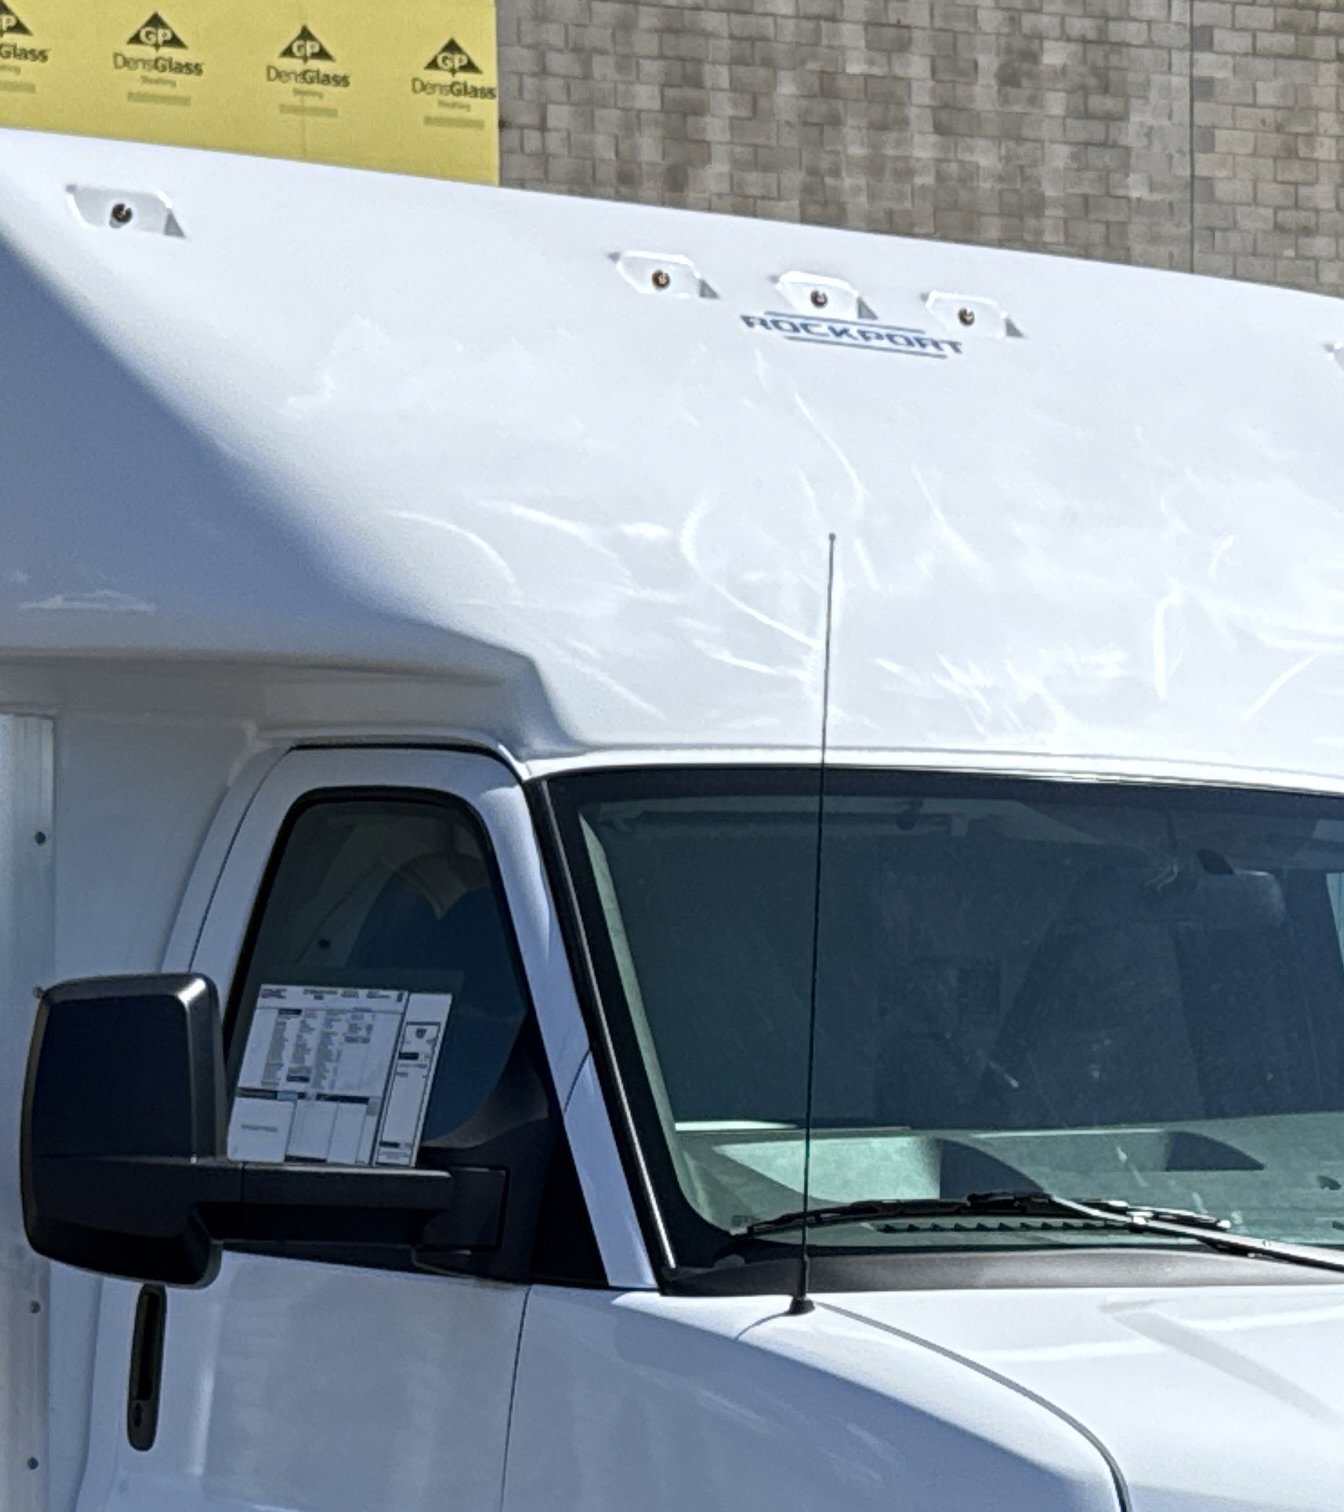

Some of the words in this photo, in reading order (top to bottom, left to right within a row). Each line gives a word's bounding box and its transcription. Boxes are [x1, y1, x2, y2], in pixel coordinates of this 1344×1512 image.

[139, 26, 173, 45] GP
[291, 39, 321, 58] GP
[112, 52, 204, 76] DensGlass
[435, 51, 468, 70] GP
[266, 64, 351, 88] DensGlass
[411, 77, 497, 100] DensGlass
[739, 314, 963, 354] ROCKPORT
